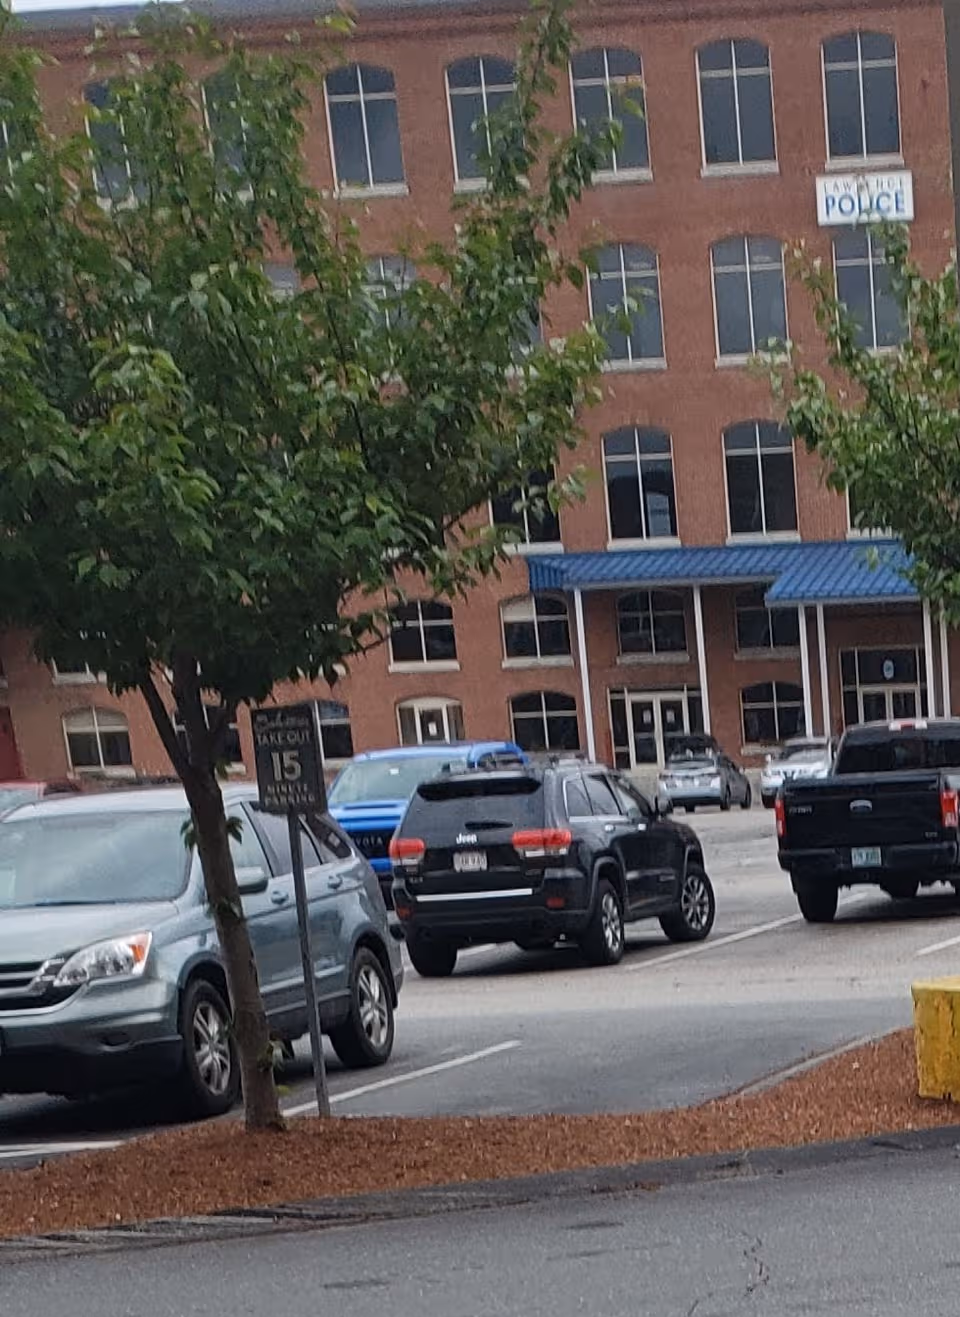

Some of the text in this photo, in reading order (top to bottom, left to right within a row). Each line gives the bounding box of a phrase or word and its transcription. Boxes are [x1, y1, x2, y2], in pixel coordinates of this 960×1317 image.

[824, 176, 903, 193] LAWNCE
[825, 189, 905, 220] POLICE
[271, 750, 302, 782] 15
[456, 832, 477, 845] Jeep
